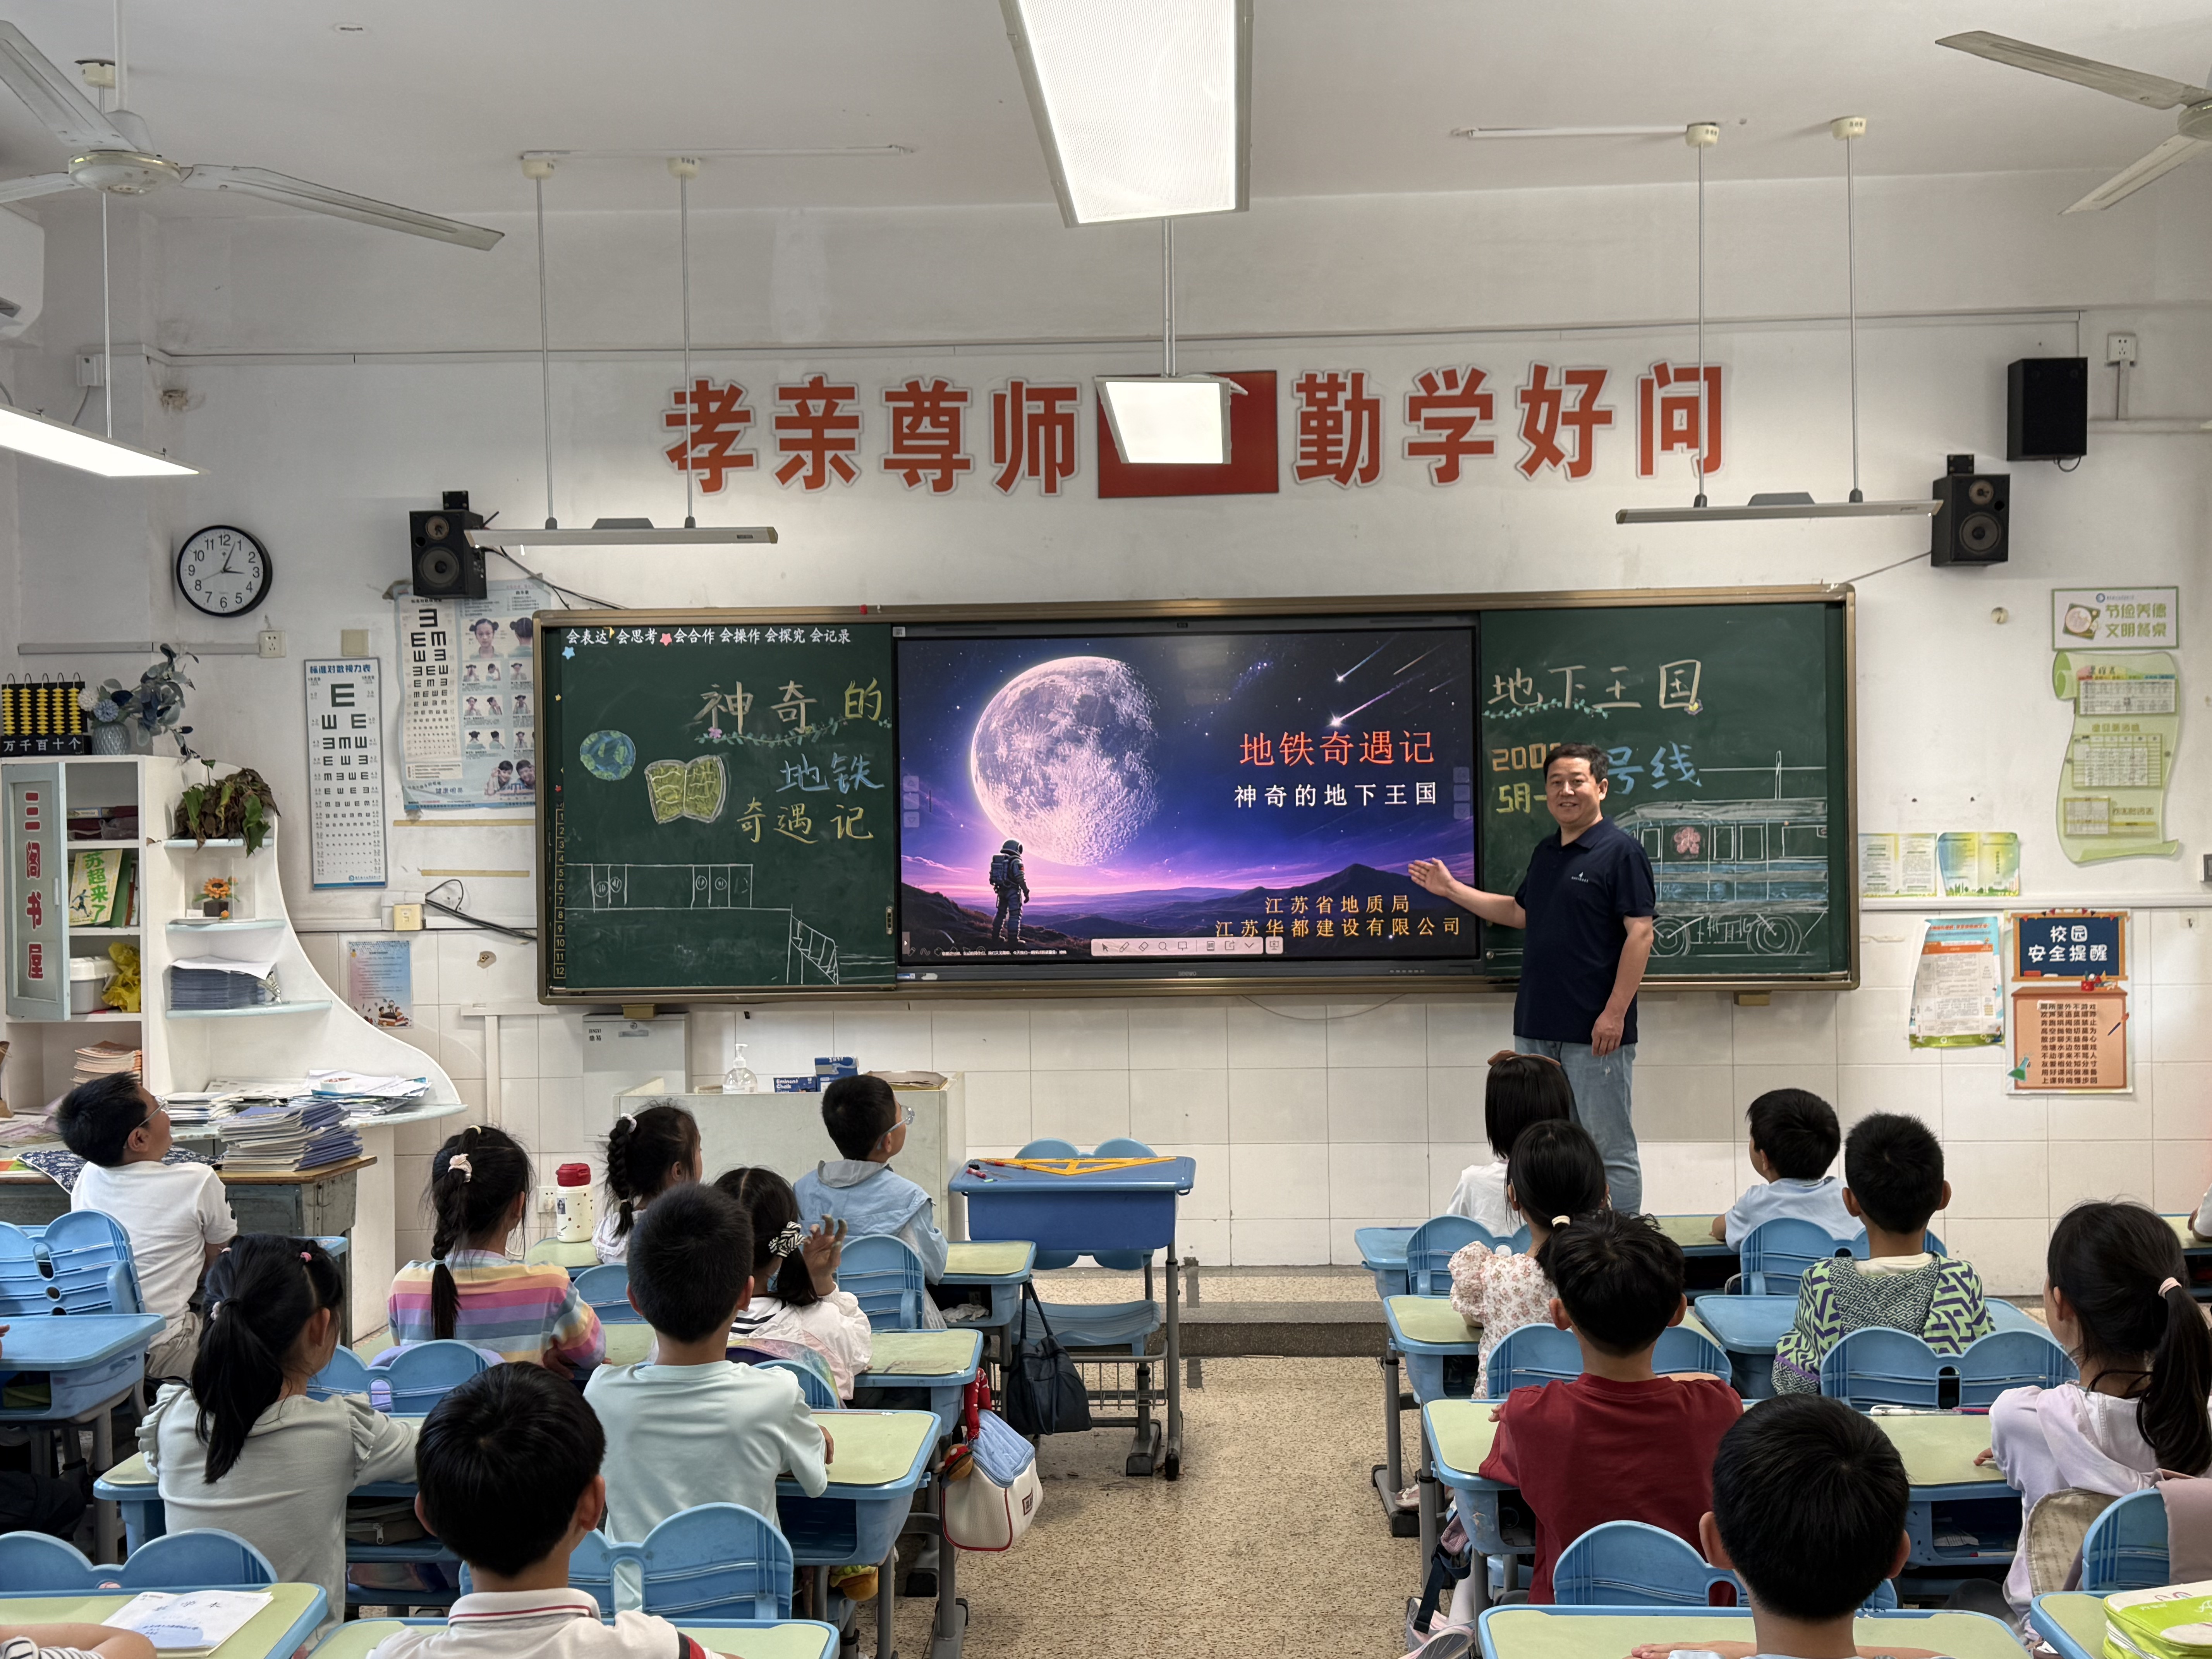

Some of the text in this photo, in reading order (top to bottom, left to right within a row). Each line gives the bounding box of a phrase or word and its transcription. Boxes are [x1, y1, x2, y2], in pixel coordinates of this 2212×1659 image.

[664, 362, 1723, 495] 孝亲尊师 勤学好问
[205, 539, 213, 550] 11
[218, 534, 230, 546] 12
[237, 539, 241, 551] 1
[193, 550, 204, 562] 10
[248, 552, 256, 563] 2
[188, 565, 195, 576] 9
[252, 567, 259, 578] 3
[195, 579, 201, 591] 8
[246, 581, 253, 592] 4
[205, 591, 212, 603] 7
[220, 597, 227, 608] 6
[235, 592, 242, 604] 5
[566, 627, 851, 645] 会表达 会思考 会合作 会操作 会探究 会记录
[1487, 660, 1701, 709] 地下王国
[694, 678, 882, 734] 神奇的
[1239, 730, 1434, 767] 地铁奇遇记
[776, 754, 884, 794] 地铁
[1234, 782, 1436, 808] 神奇的地下王国
[737, 797, 874, 843] 奇遇记
[82, 851, 108, 923] 苏超来了
[1265, 895, 1409, 915] 江苏省地质局
[1215, 916, 1460, 937] 江苏华都建设有限公司
[2050, 925, 2088, 943] 校园
[2028, 944, 2107, 963] 安全提醒
